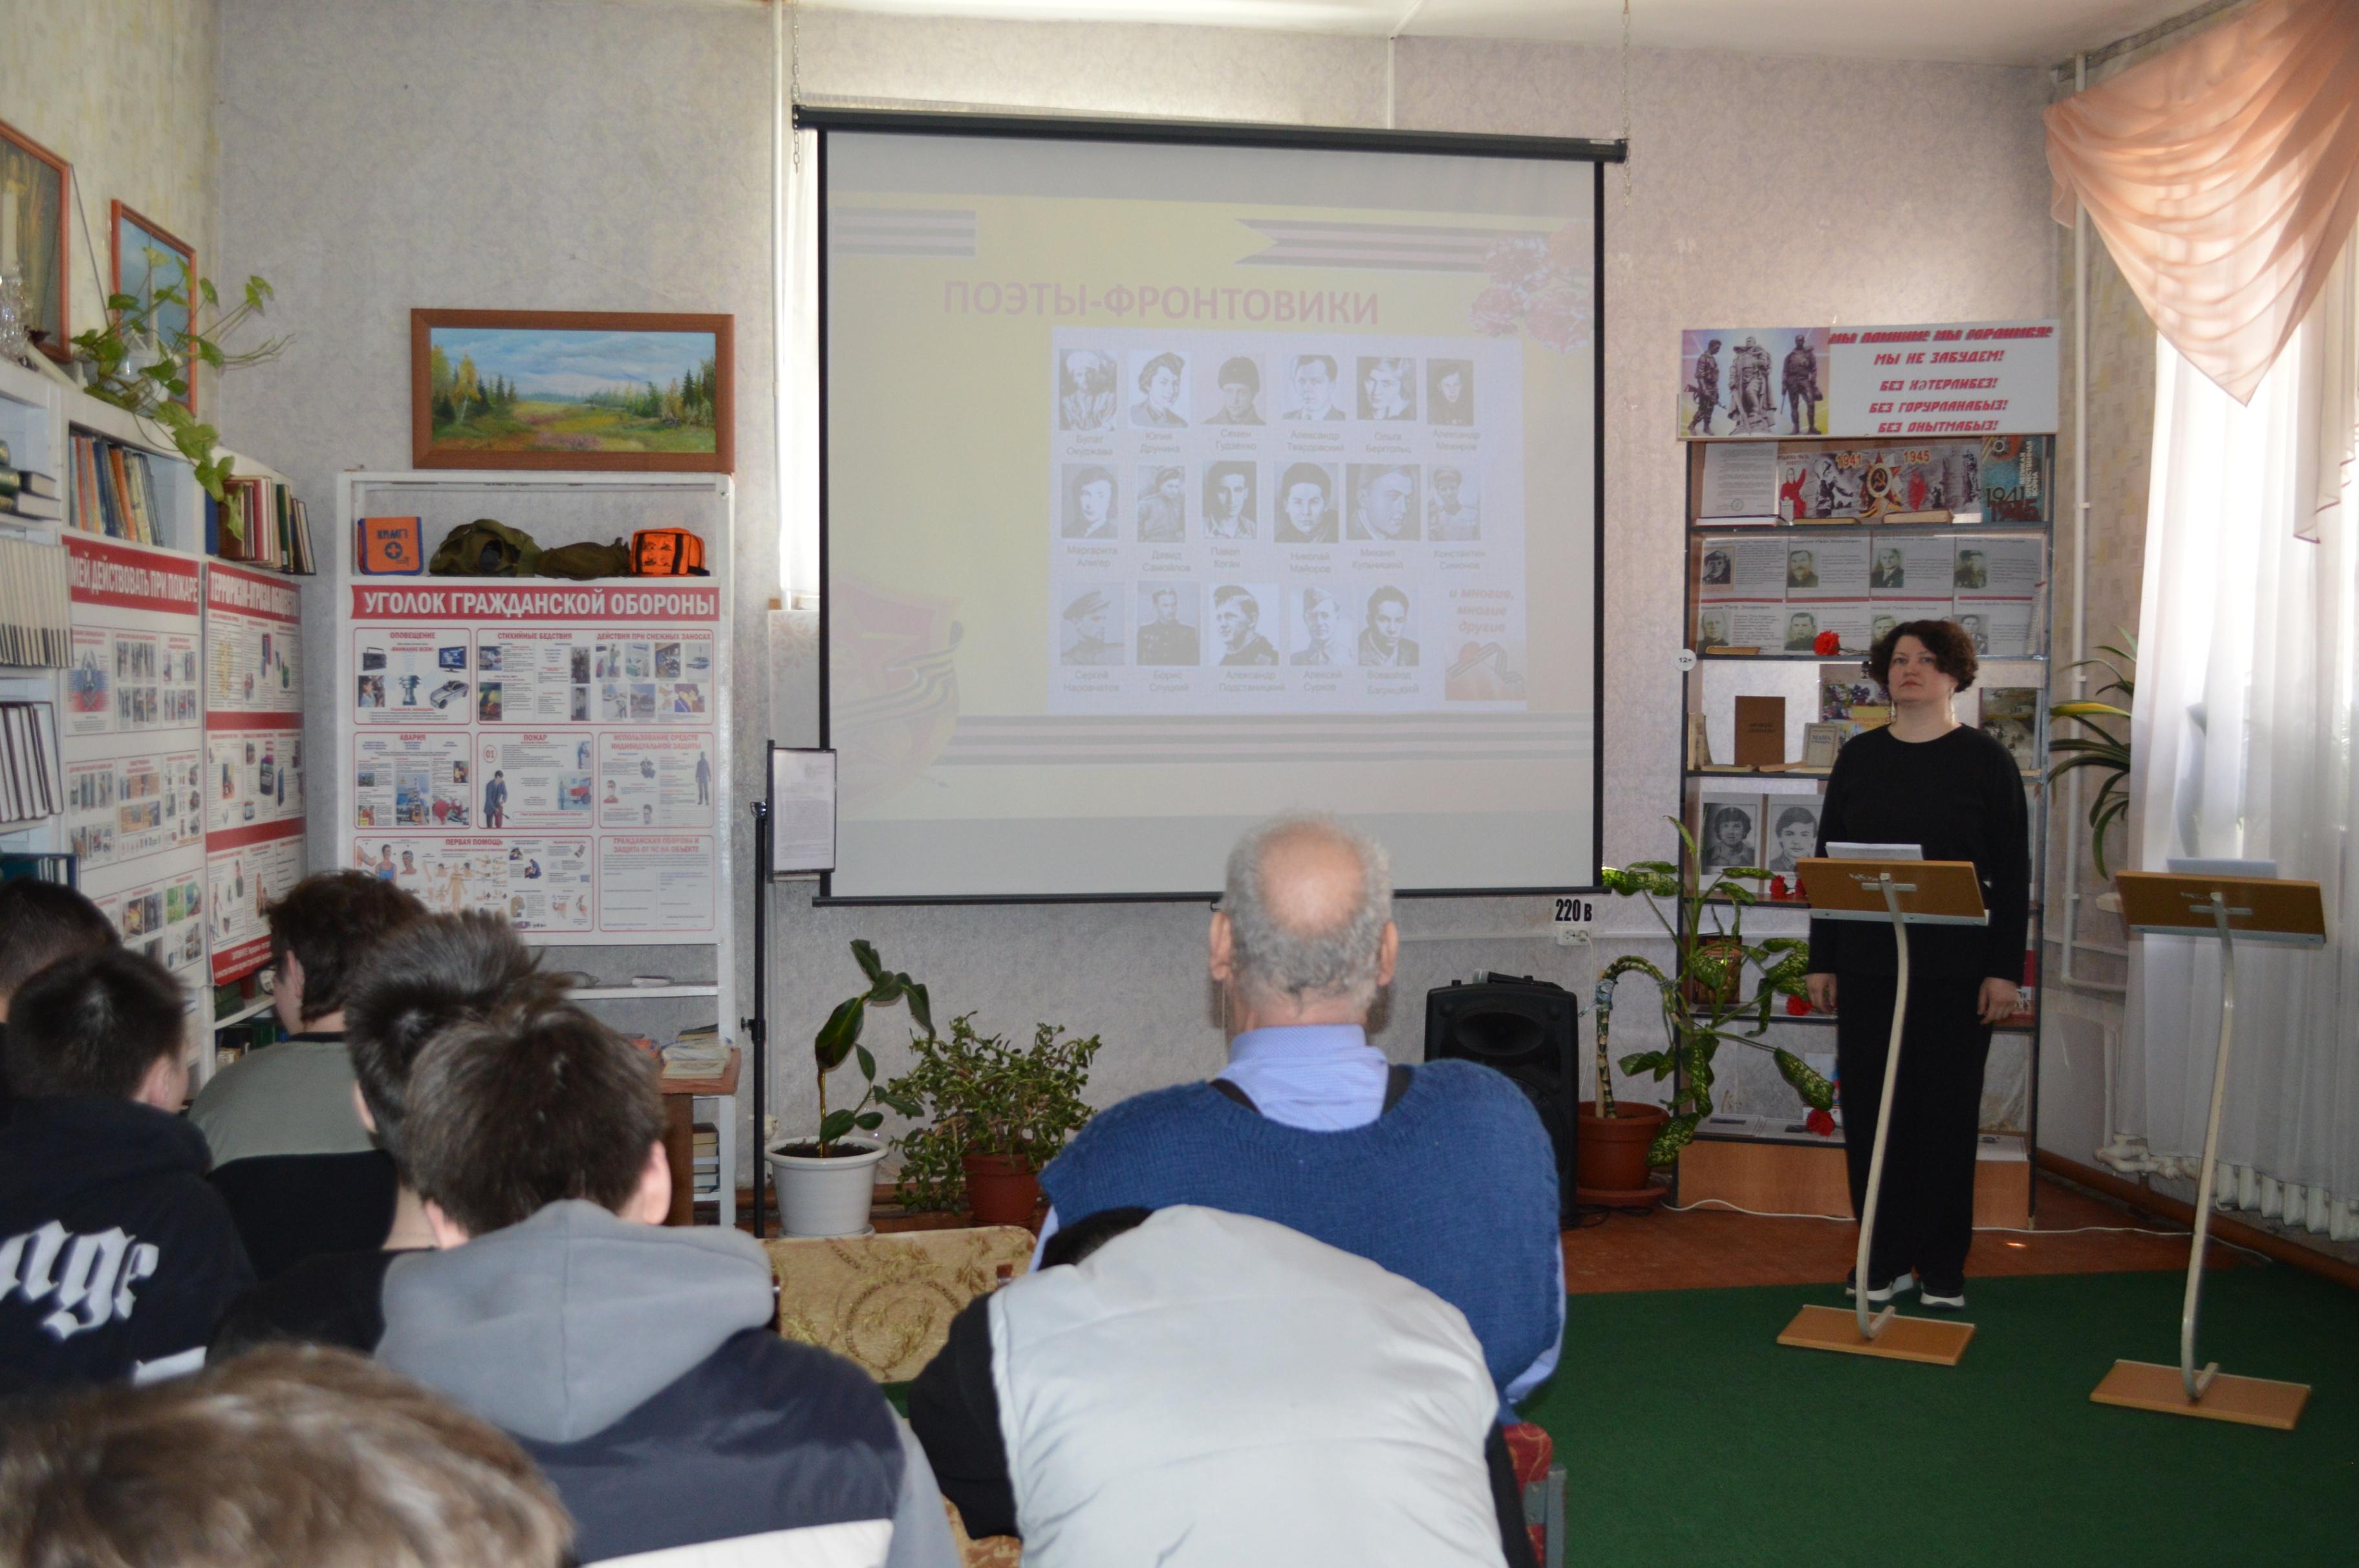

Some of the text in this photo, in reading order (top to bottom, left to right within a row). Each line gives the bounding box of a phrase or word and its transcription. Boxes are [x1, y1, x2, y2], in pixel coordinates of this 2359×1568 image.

[943, 281, 1379, 325] ПОЭТЫ-ФРОНТОВИКИ
[1827, 332, 1857, 345] МЫ
[1933, 329, 1961, 342] МЫ
[1873, 350, 2005, 365] МЫ НЕ ЗАБУДЕМ!
[1879, 380, 1904, 392] БЕЗ
[1869, 400, 2008, 414] БЕЗ ГОРУРЛАНАБЫЗ!
[1877, 420, 1999, 433] БЕЗ ОНЫТМАБЫЗ!
[1220, 429, 1251, 438] Семен
[1290, 431, 1341, 442] Александр
[1374, 432, 1402, 441] Ольга
[1215, 441, 1257, 453] Гудзенко
[1835, 453, 1862, 468] 1941
[1904, 450, 1930, 463] 1945
[1986, 486, 2025, 508] 1941
[1067, 546, 1119, 556] Маргарита
[1152, 550, 1182, 561] Давид
[1210, 547, 1240, 556] Павел
[70, 552, 199, 603] МЕЙ ДЕЙСТВОВАТЬ ПРИ ПОЖАРЕ
[1461, 589, 1514, 600] многие,
[365, 588, 715, 618] УГОЛОК ГРАЖДАНСКОЙ ОБОРОНЫ
[1457, 606, 1507, 616] многие
[1458, 619, 1506, 634] другие
[497, 631, 537, 639] СТИХИЙНЫЕ
[597, 632, 630, 640] ДЕЙСТВИЯ
[1154, 671, 1183, 681] Борис
[1225, 670, 1276, 681] Александр
[1303, 670, 1343, 680] Алексей
[1303, 683, 1337, 694] Сурков
[486, 750, 495, 758] 01
[1555, 899, 1592, 921] 220 В
